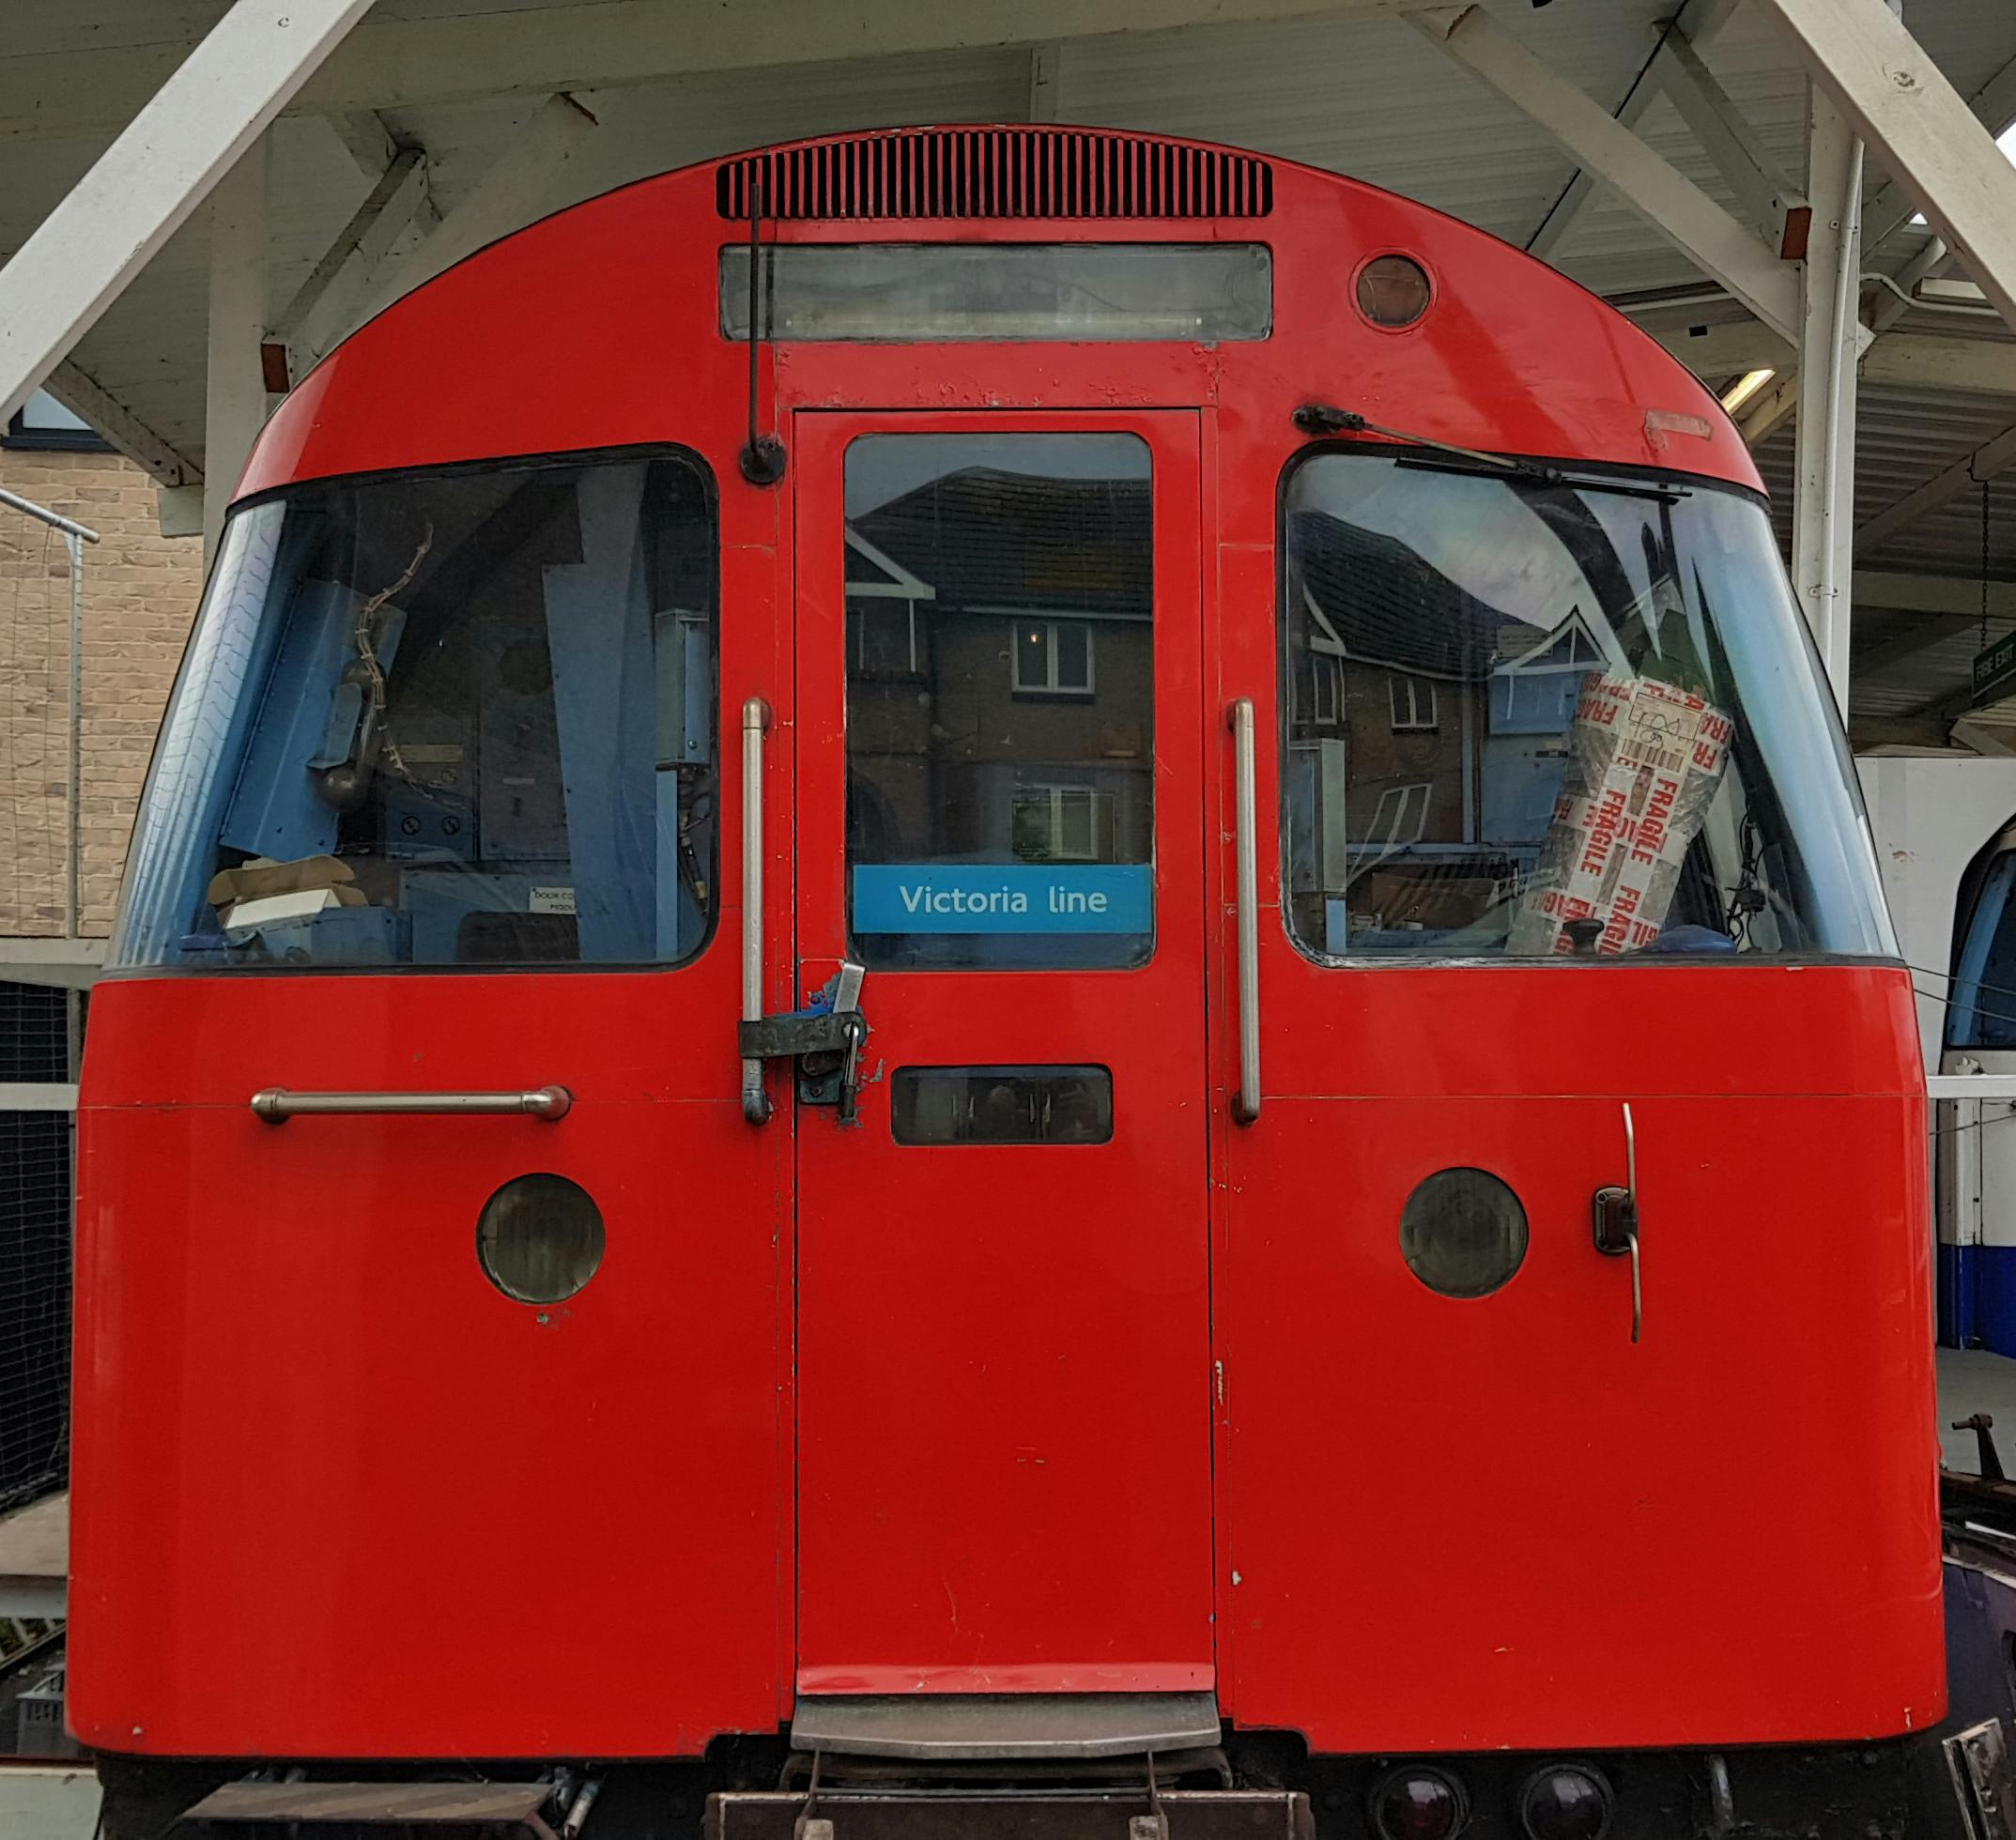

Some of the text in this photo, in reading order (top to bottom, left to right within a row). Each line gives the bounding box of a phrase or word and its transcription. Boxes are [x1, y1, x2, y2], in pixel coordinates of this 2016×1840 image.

[1579, 789, 1626, 877] FRAGILE
[1630, 777, 1678, 866] FRAGILE
[899, 885, 1108, 913] Victoria line
